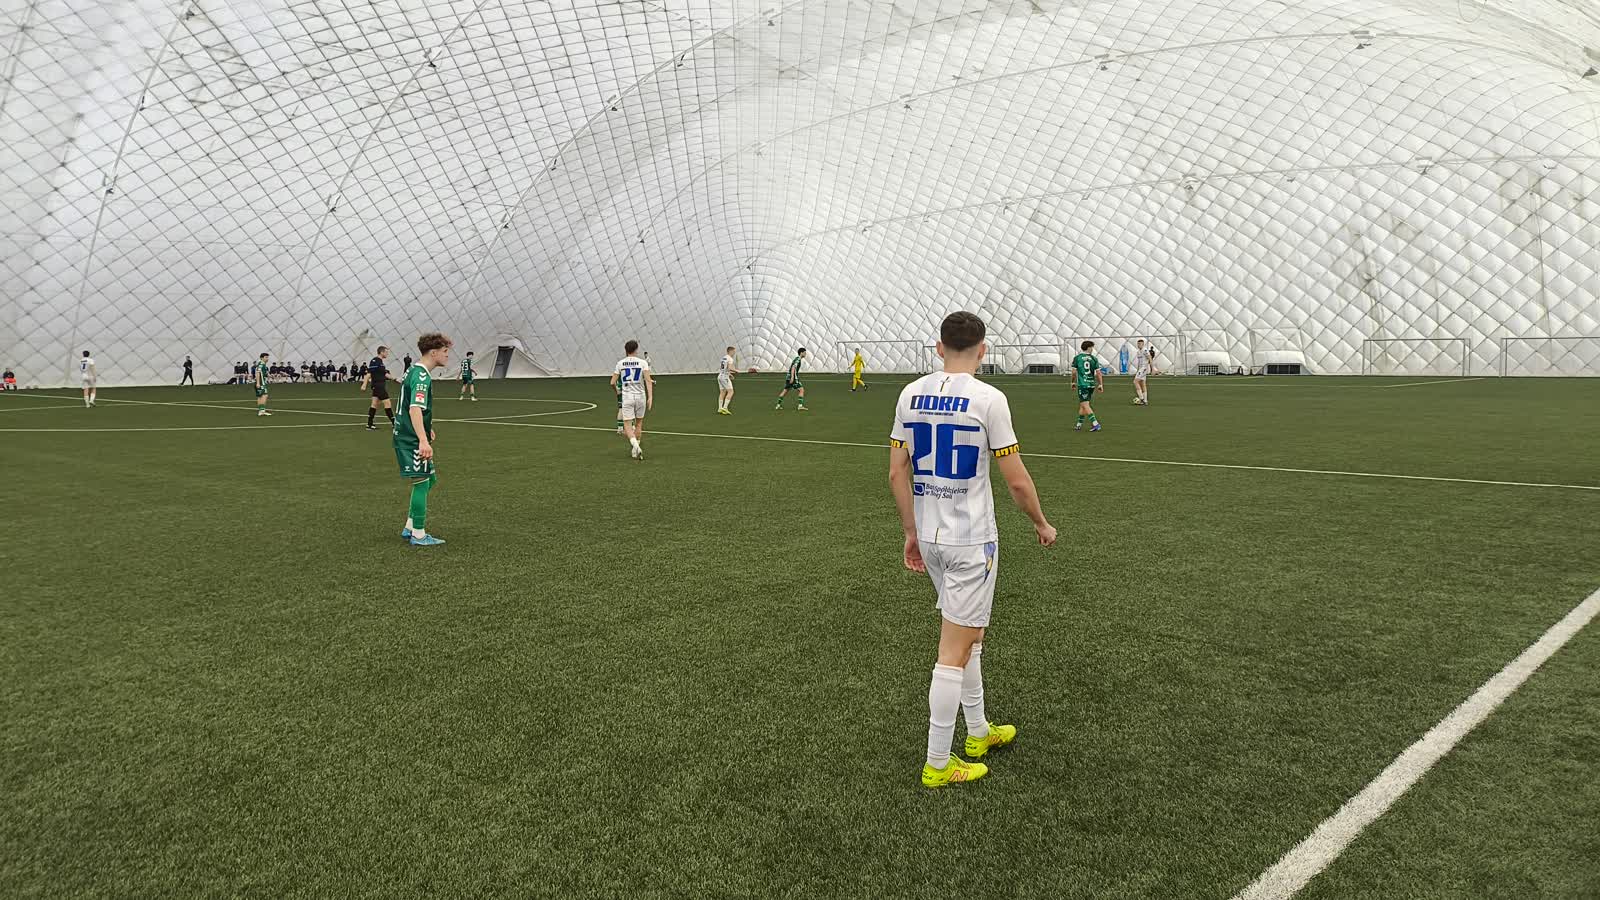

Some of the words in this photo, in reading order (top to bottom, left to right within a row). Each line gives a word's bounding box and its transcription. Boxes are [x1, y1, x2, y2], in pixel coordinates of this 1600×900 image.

[621, 367, 641, 381] 27
[1083, 361, 1091, 375] 9
[903, 422, 980, 480] 26
